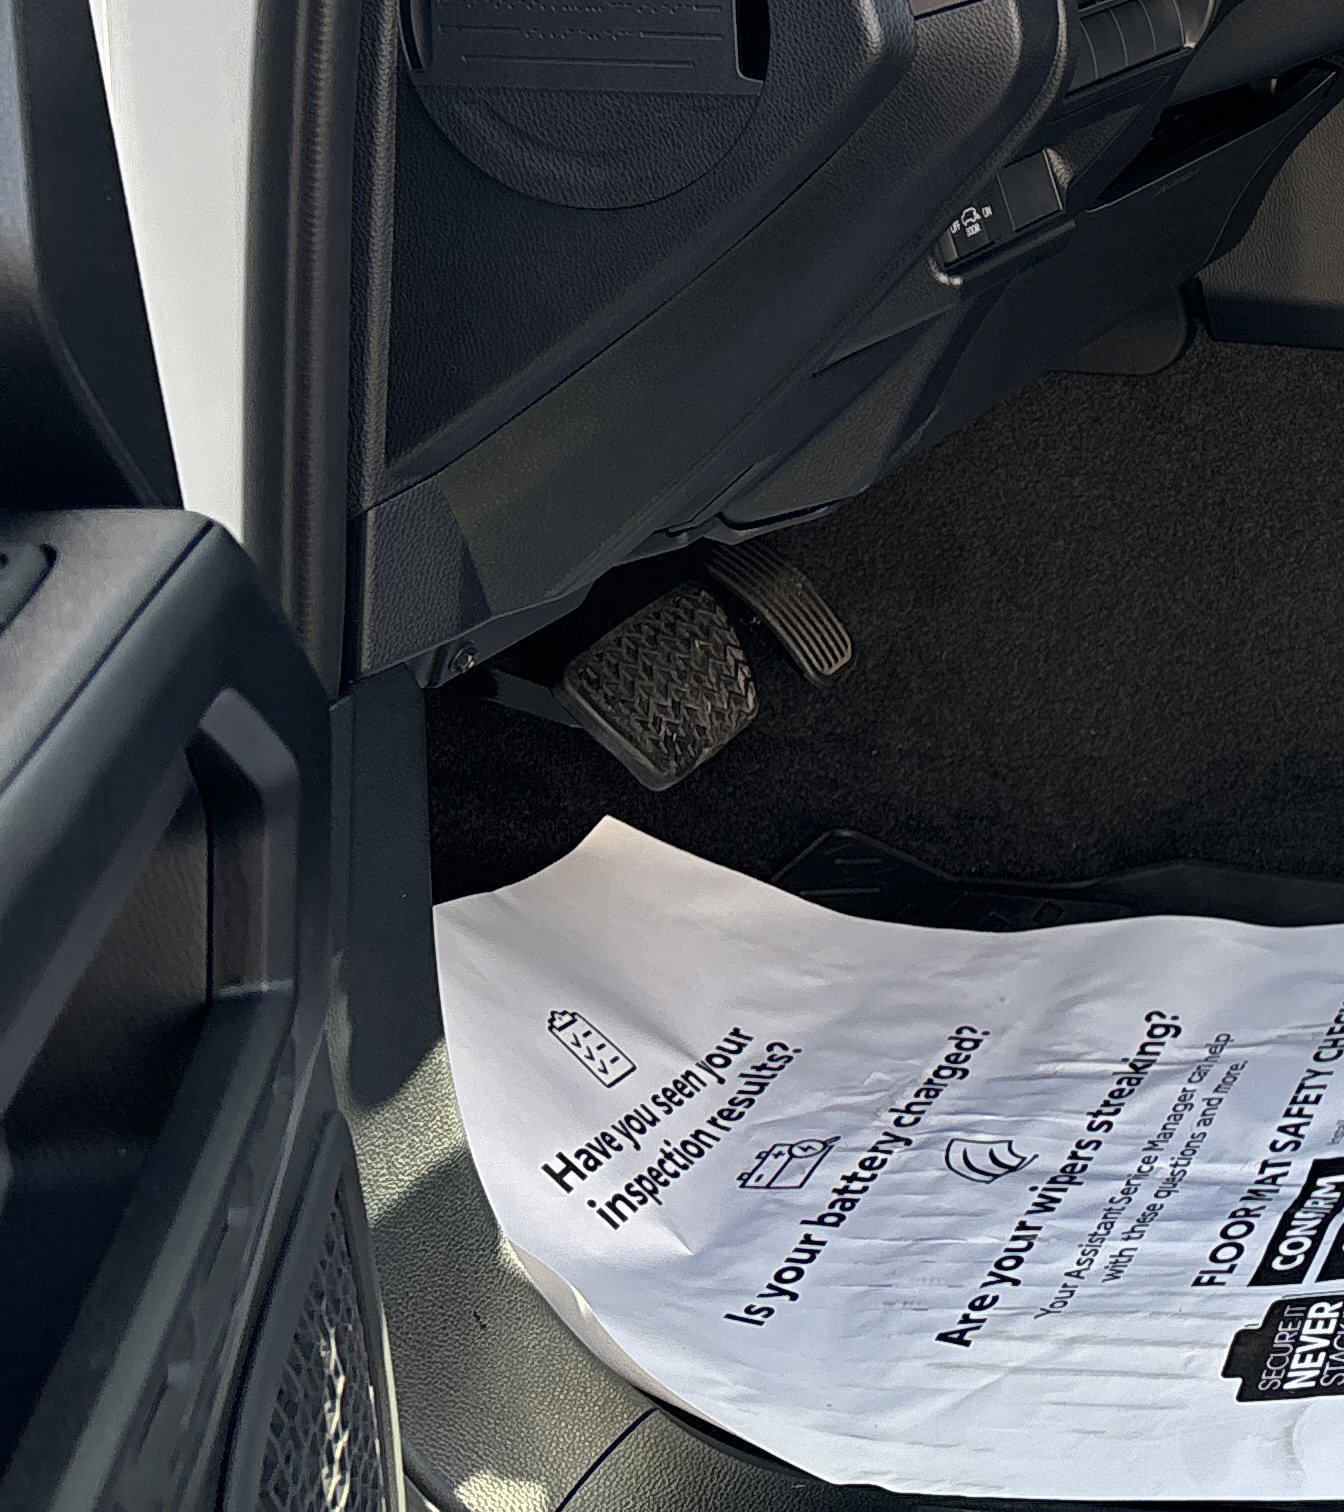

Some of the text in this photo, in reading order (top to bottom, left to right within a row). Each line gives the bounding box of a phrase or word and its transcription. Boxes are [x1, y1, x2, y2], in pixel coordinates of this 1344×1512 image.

[541, 1027, 754, 1194] Have you seen your
[587, 1041, 802, 1230] inspection results?
[723, 1025, 990, 1327] Is your battery charged?
[935, 1010, 1182, 1348] Are your wipers streaking?
[1034, 1282, 1079, 1319] Your
[1064, 1204, 1126, 1280] Assistant
[1142, 1087, 1196, 1153] Manager
[1204, 1033, 1235, 1063] help
[1102, 1060, 1249, 1283] with these questions and more.
[1190, 1202, 1267, 1288] FLOOR
[1239, 1158, 1293, 1202] MAT
[1269, 1068, 1334, 1153] SAFETY
[1258, 1304, 1307, 1391] SECURE IT
[1283, 1301, 1344, 1390] NEVER
